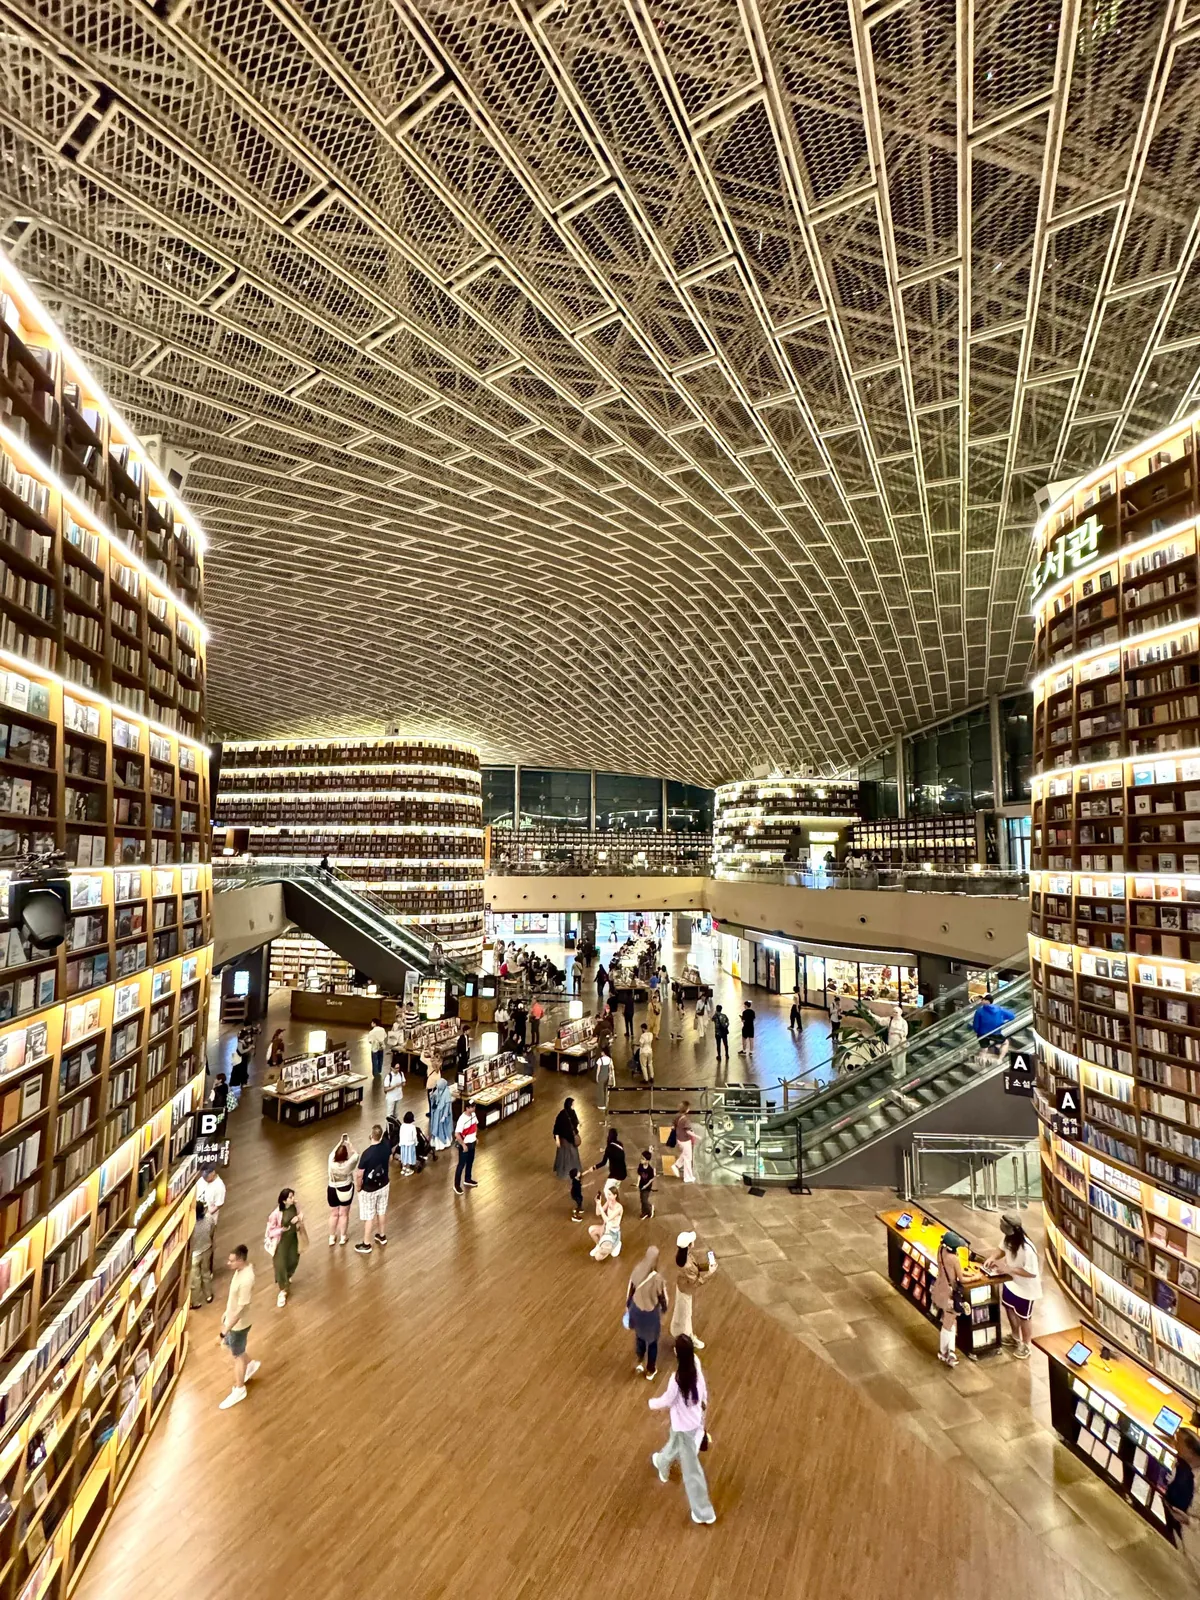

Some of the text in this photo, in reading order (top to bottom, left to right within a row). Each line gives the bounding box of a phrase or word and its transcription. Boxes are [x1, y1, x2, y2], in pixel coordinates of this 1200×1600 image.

[1013, 1055, 1028, 1071] A
[1012, 1079, 1031, 1089] 소설
[1061, 1091, 1076, 1110] A
[201, 1114, 217, 1134] B
[196, 1143, 218, 1153] 비소설
